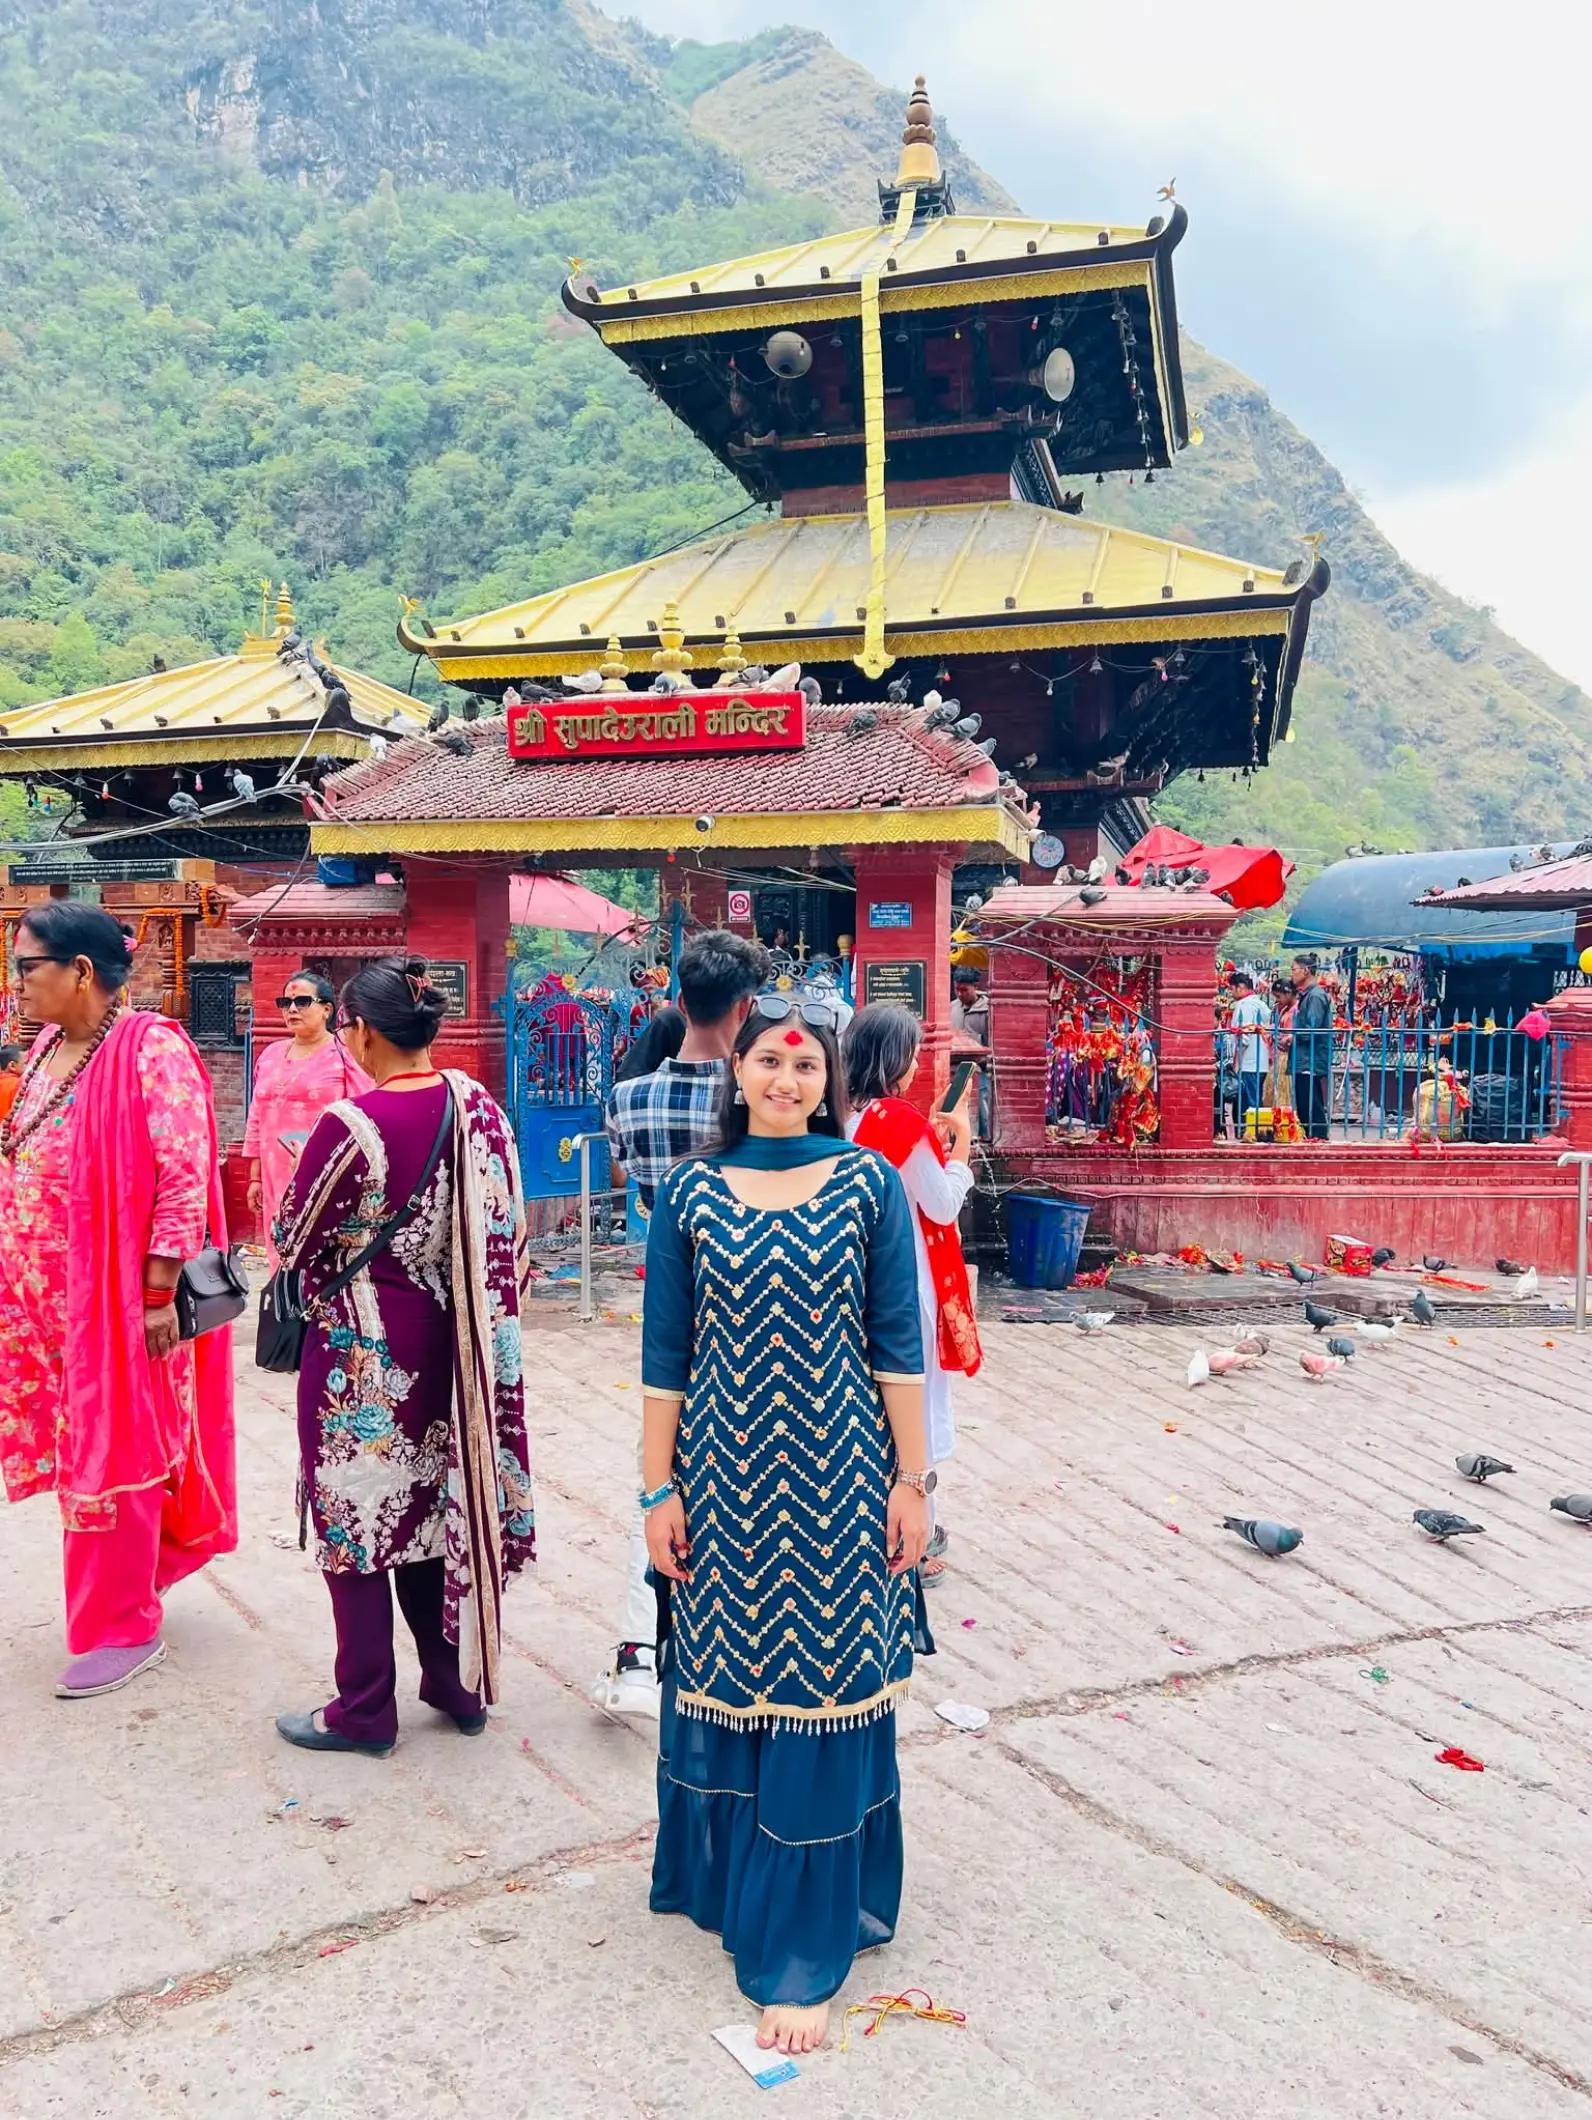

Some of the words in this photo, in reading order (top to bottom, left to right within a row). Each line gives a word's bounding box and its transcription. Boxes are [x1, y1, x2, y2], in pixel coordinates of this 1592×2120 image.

[514, 709, 547, 746] श्री
[552, 702, 698, 750] सुपादेउराली
[704, 698, 791, 736] मन्दिर
